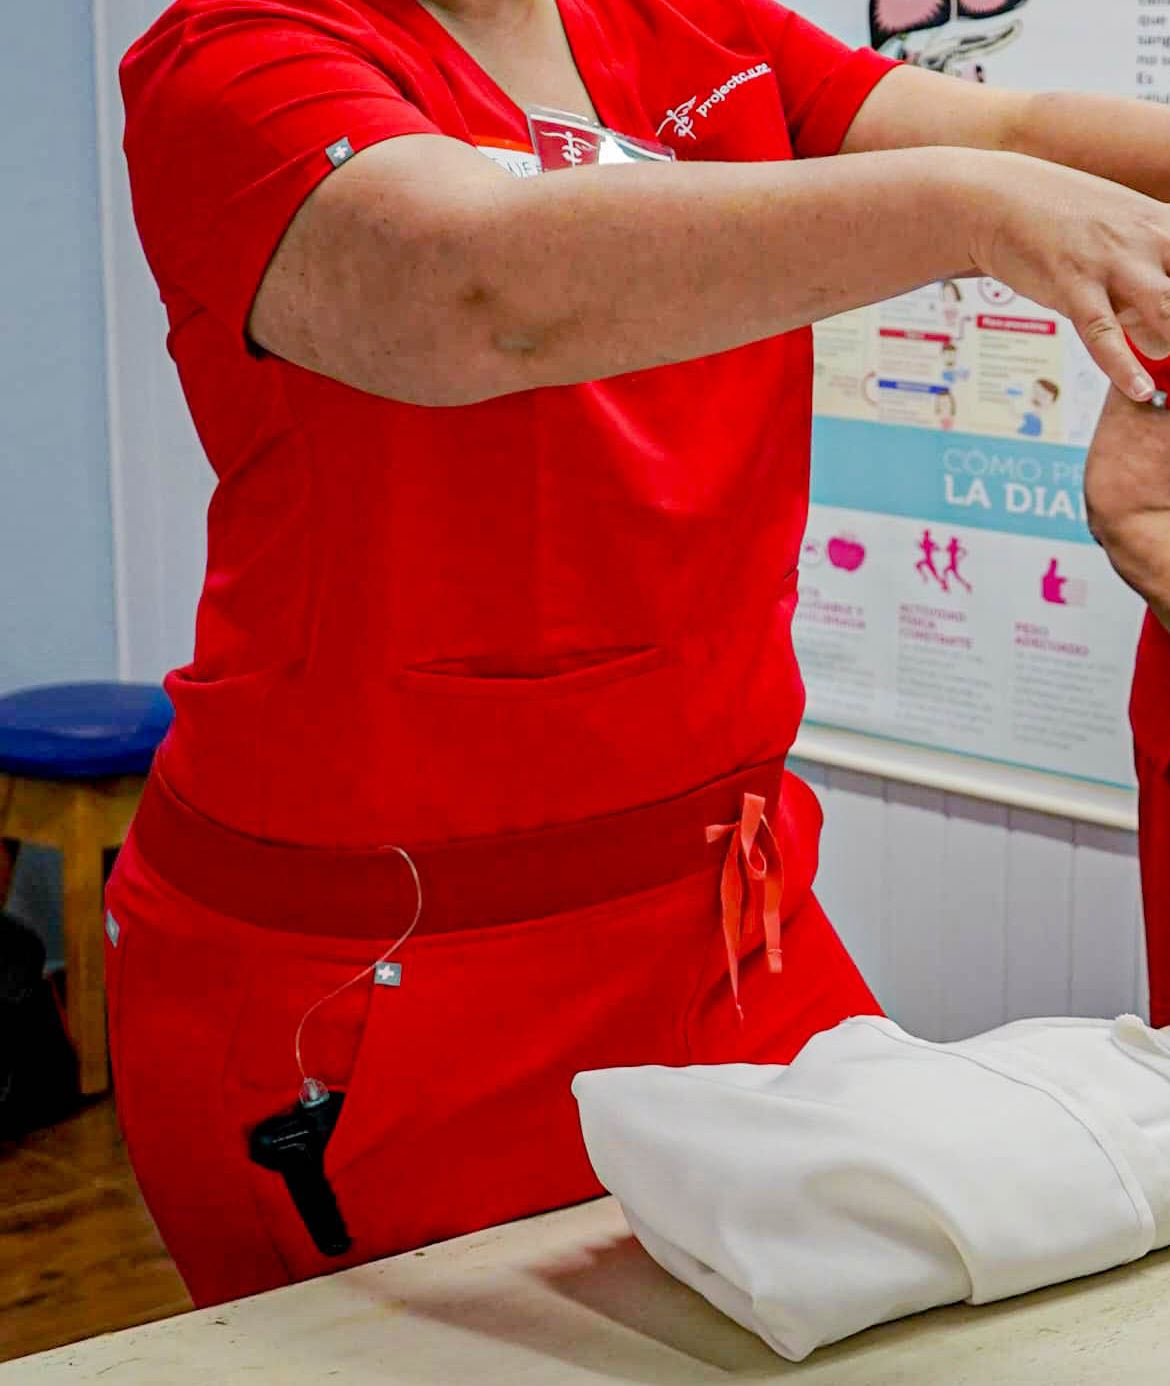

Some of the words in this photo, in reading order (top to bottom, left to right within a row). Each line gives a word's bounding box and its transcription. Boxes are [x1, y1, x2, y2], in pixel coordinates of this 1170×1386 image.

[1137, 15, 1167, 29] que
[1051, 459, 1085, 487] PR
[944, 473, 993, 510] LA
